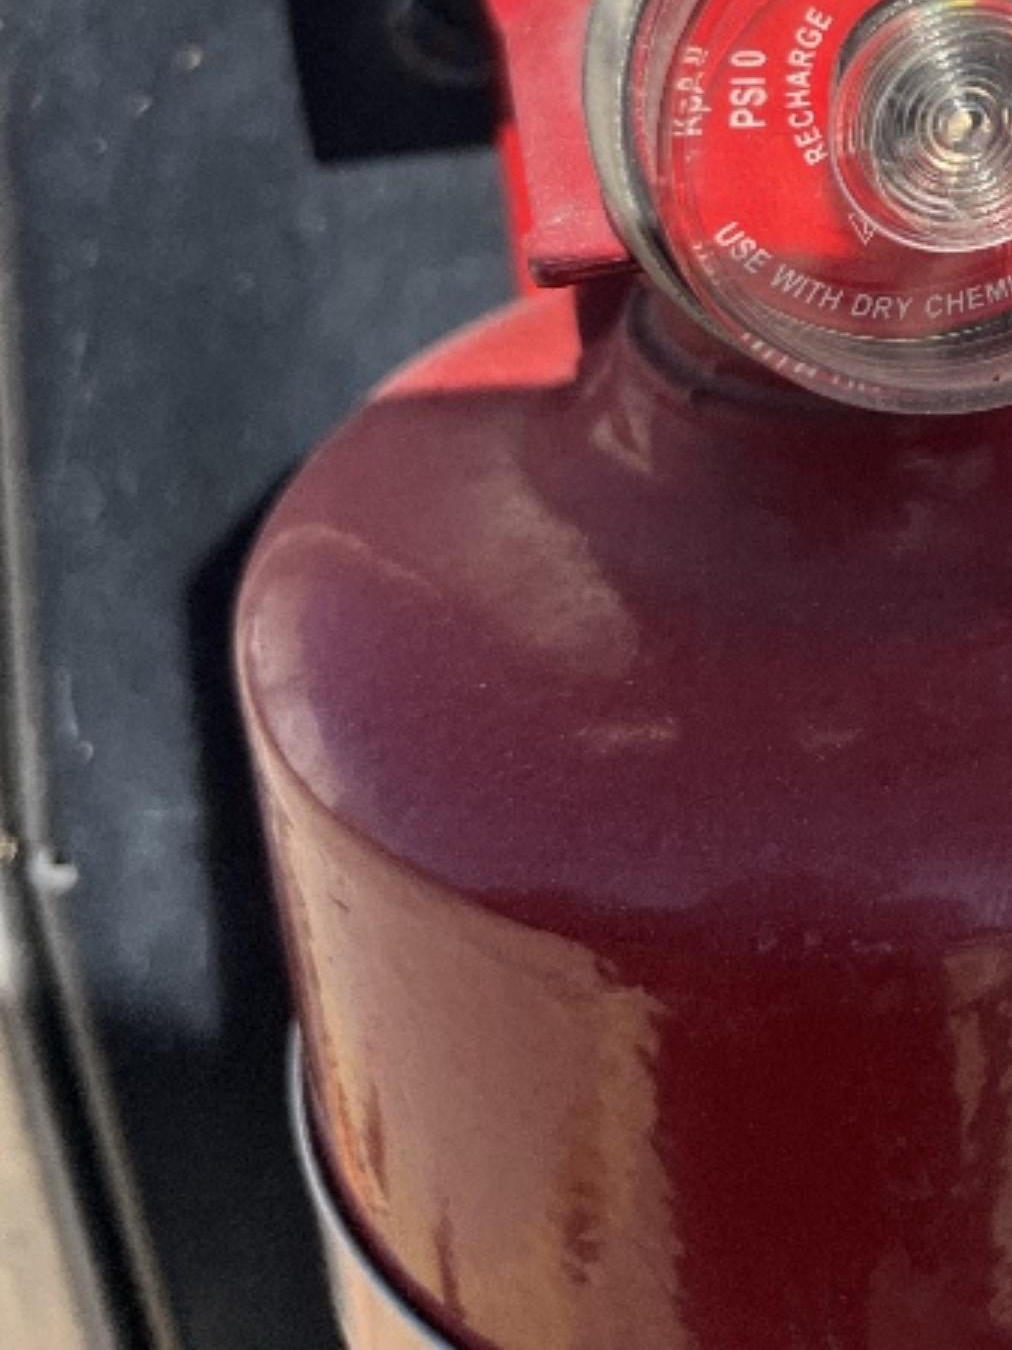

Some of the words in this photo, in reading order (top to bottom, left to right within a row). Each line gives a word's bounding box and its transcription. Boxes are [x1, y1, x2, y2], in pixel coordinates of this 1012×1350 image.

[729, 49, 768, 68] 0
[784, 6, 833, 166] RECHARGE
[728, 77, 768, 129] PSI
[714, 221, 773, 274] USE
[770, 264, 844, 311] WITH
[851, 293, 913, 320] DRY
